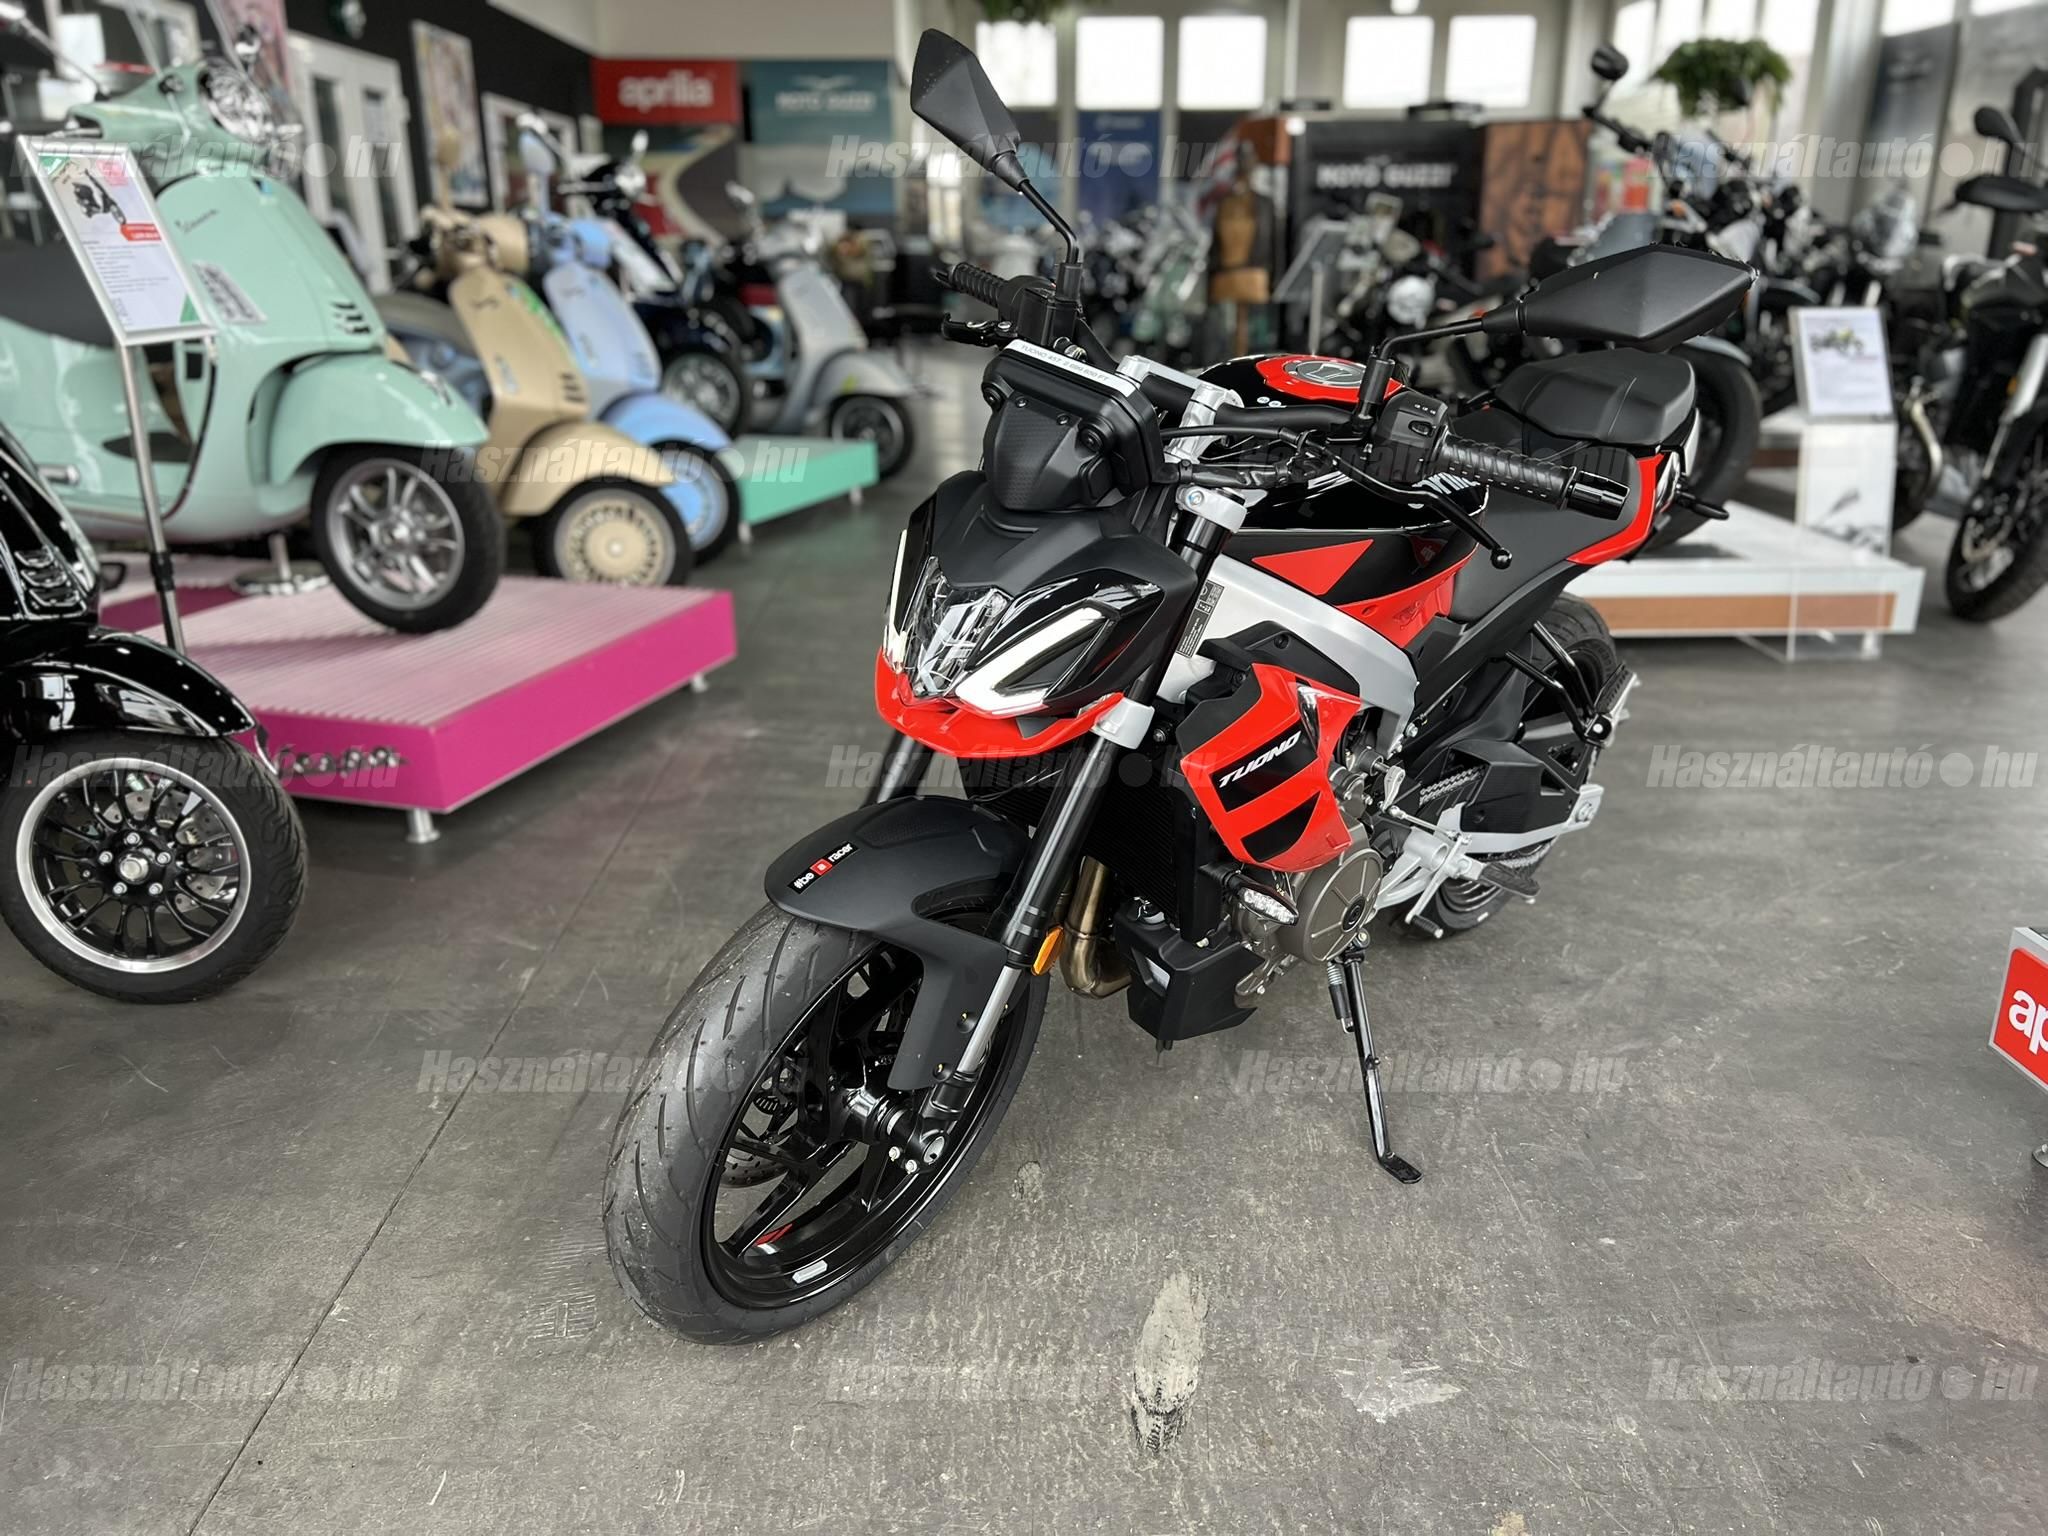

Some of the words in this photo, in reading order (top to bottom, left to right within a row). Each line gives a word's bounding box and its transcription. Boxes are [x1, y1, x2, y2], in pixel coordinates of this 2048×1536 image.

[618, 70, 713, 112] aprilia
[1219, 730, 1301, 788] TUONO
[827, 843, 853, 863] racer
